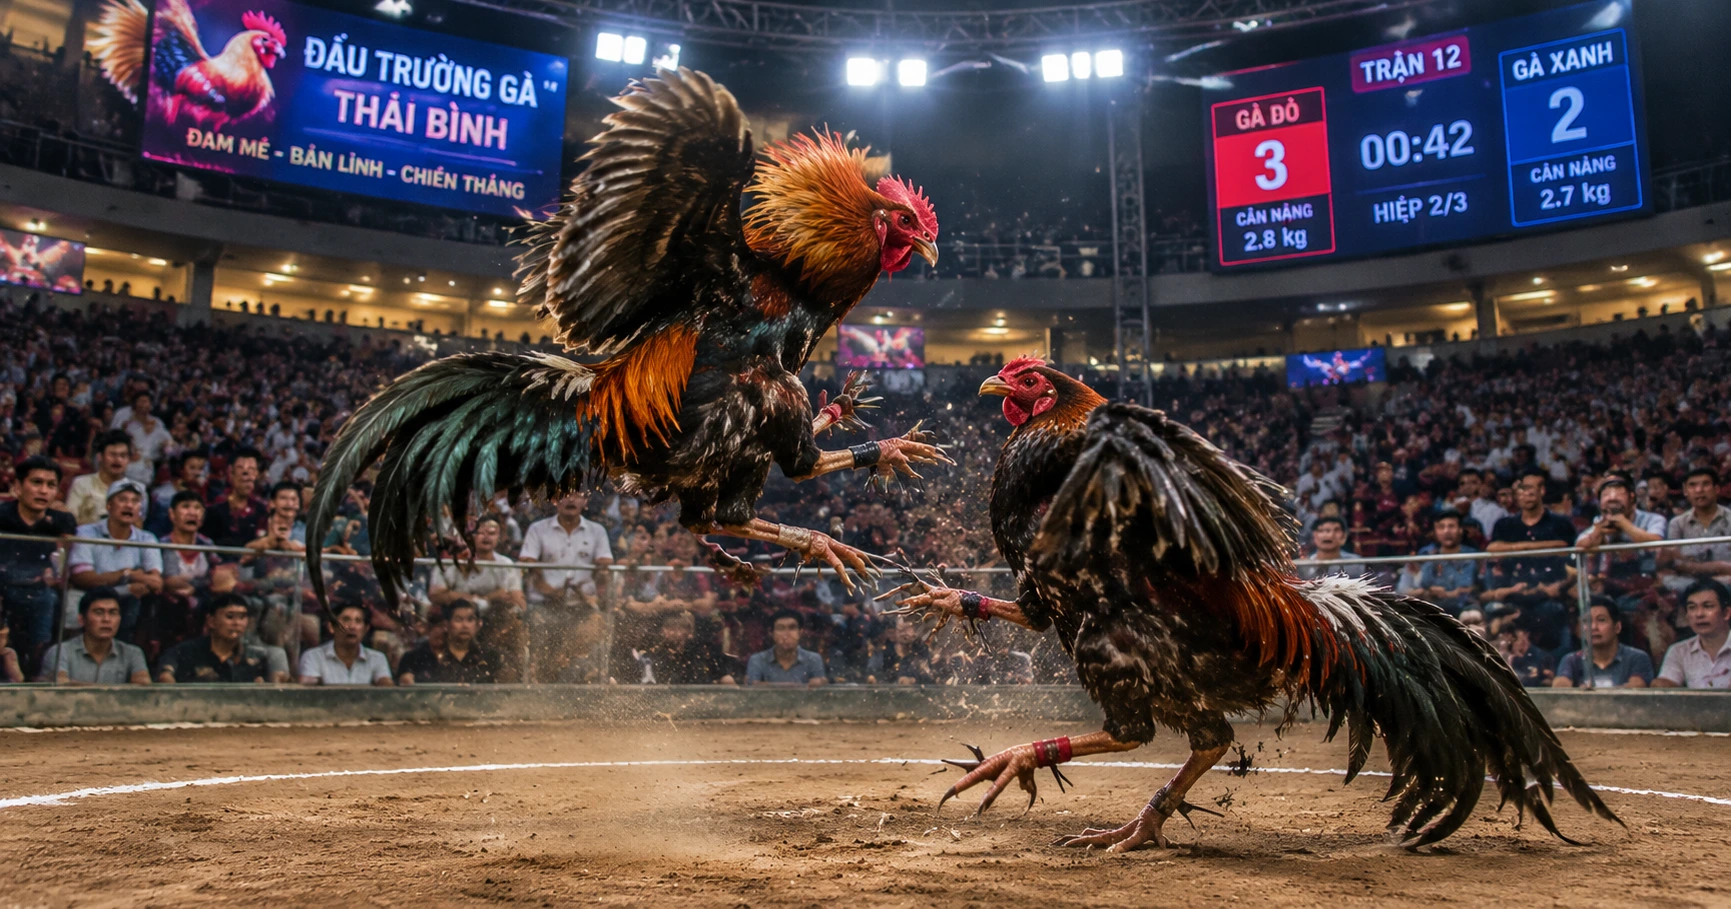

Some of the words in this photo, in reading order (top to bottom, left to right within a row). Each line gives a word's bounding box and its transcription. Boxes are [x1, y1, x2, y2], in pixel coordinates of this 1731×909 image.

[374, 49, 492, 101] TRƯỜNG
[499, 70, 539, 109] GÀ
[1360, 49, 1425, 84] TRẬN
[1432, 44, 1462, 71] 12
[1512, 51, 1545, 81] GÀ
[1549, 40, 1614, 75] XANH
[425, 100, 509, 151] BÌNH
[1235, 102, 1267, 130] GÀ
[1548, 85, 1588, 144] 2
[186, 127, 235, 154] ĐAM
[1360, 119, 1475, 171] 00:42
[1254, 139, 1289, 191] 3
[1428, 191, 1468, 217] 2/3
[1540, 184, 1576, 211] 2.7
[1581, 181, 1611, 206] kg
[1243, 229, 1276, 252] 2.8
[1281, 226, 1308, 250] kg
